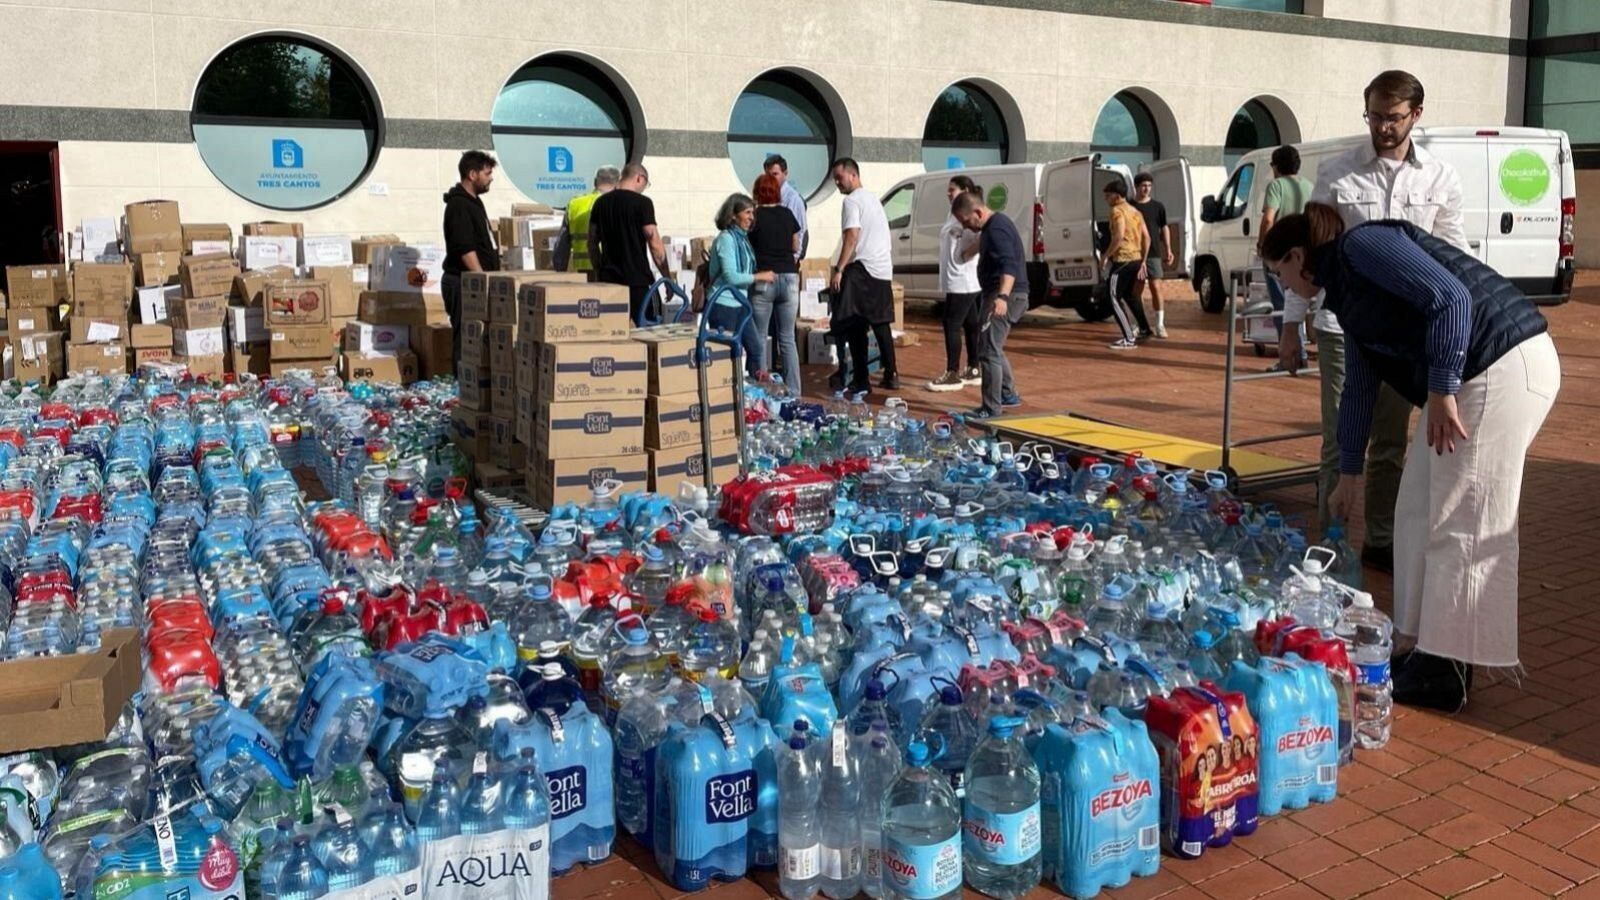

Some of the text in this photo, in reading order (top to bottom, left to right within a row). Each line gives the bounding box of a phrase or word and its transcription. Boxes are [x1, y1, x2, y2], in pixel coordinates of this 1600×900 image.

[257, 180, 321, 188] TRES CANTOS
[556, 183, 587, 191] CANTOS
[581, 300, 598, 308] Font
[580, 307, 599, 317] Vella
[592, 358, 612, 367] Font
[592, 366, 613, 376] Vella
[587, 414, 609, 423] Font
[586, 422, 609, 433] Vella
[591, 469, 614, 480] Font
[1278, 726, 1334, 753] BEZOYA
[546, 771, 581, 794] ont
[709, 776, 752, 801] Font
[551, 790, 583, 815] ella
[1092, 779, 1153, 818] BEZOYA
[709, 794, 754, 819] Vella
[435, 852, 532, 888] AQUA
